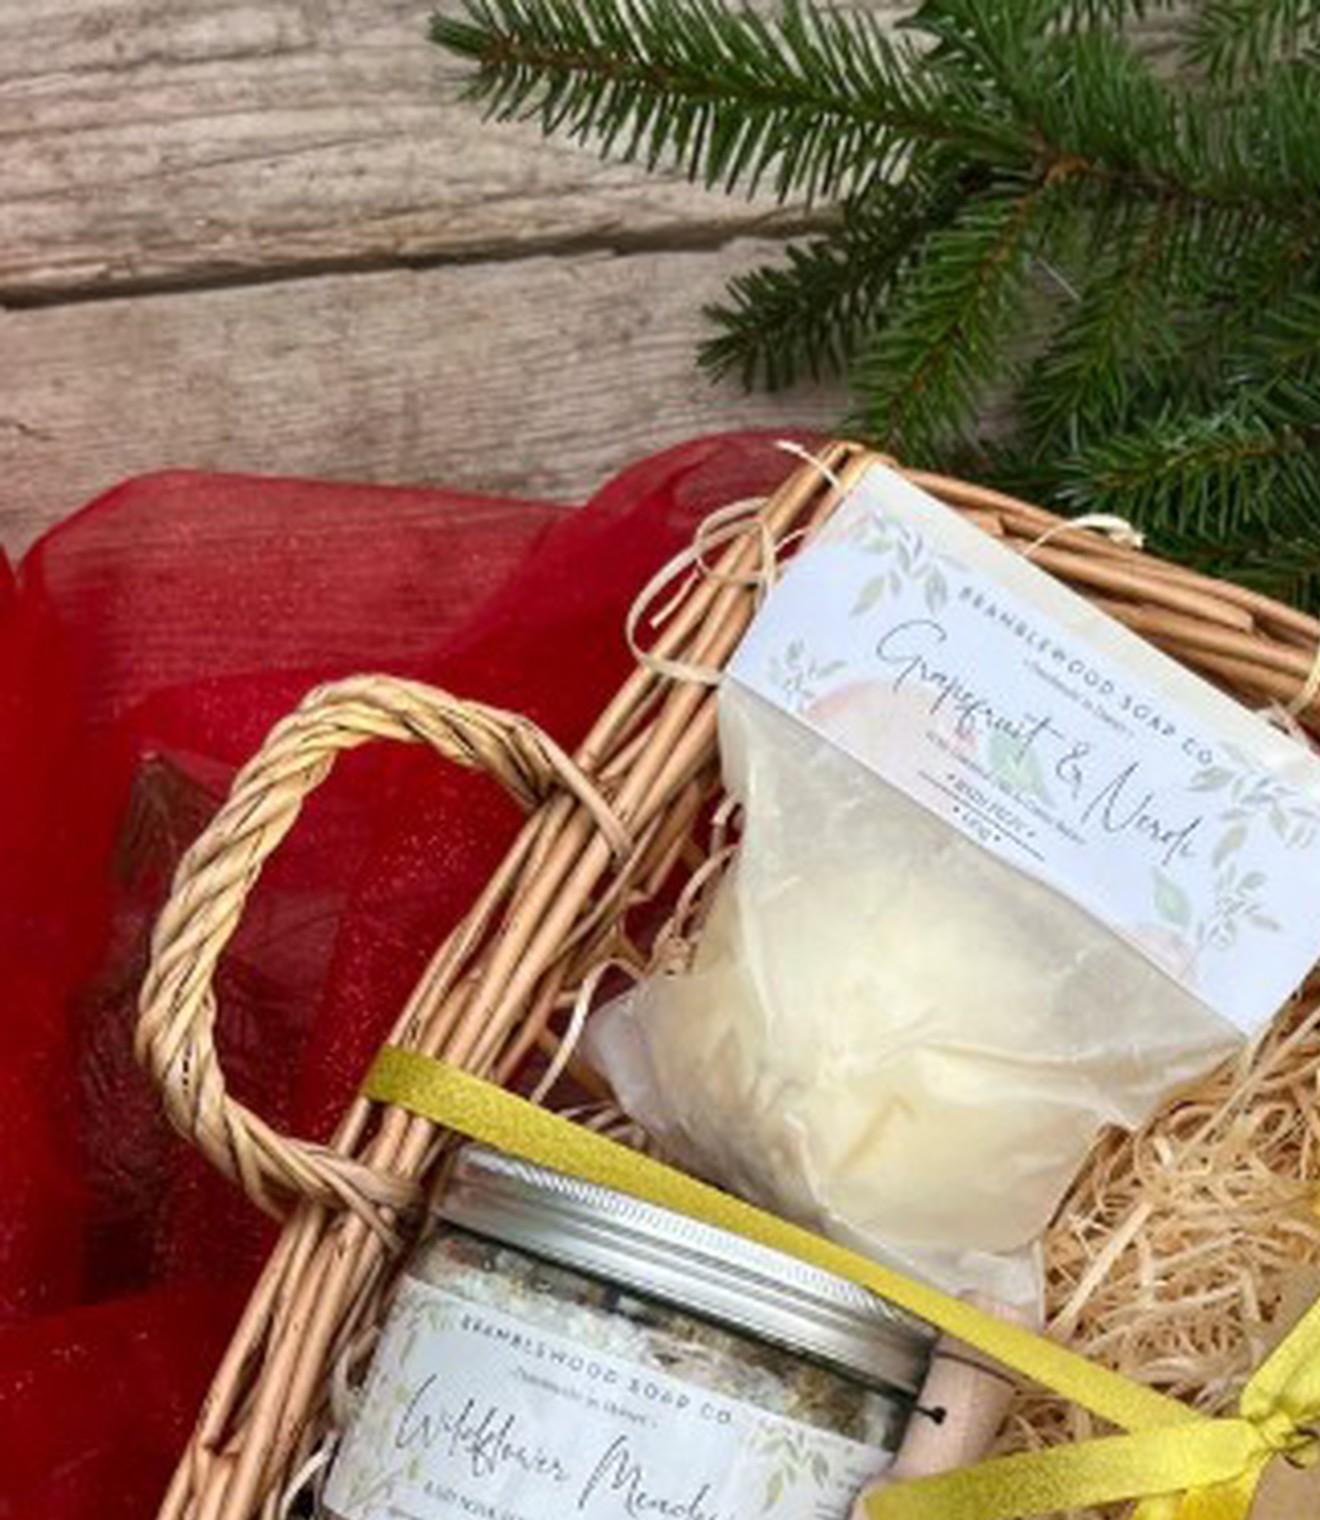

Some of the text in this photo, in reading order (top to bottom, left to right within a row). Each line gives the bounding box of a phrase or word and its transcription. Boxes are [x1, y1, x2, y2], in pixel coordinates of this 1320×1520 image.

[876, 619, 1065, 765] Grapefruit
[1055, 742, 1090, 800] &
[959, 585, 1114, 694] BRAMBLEWOOD
[1120, 695, 1176, 735] SOAP
[461, 1314, 618, 1383] BRAMBLEWOOD
[628, 1378, 690, 1409] SOAP
[395, 1373, 571, 1478] Wildflower
